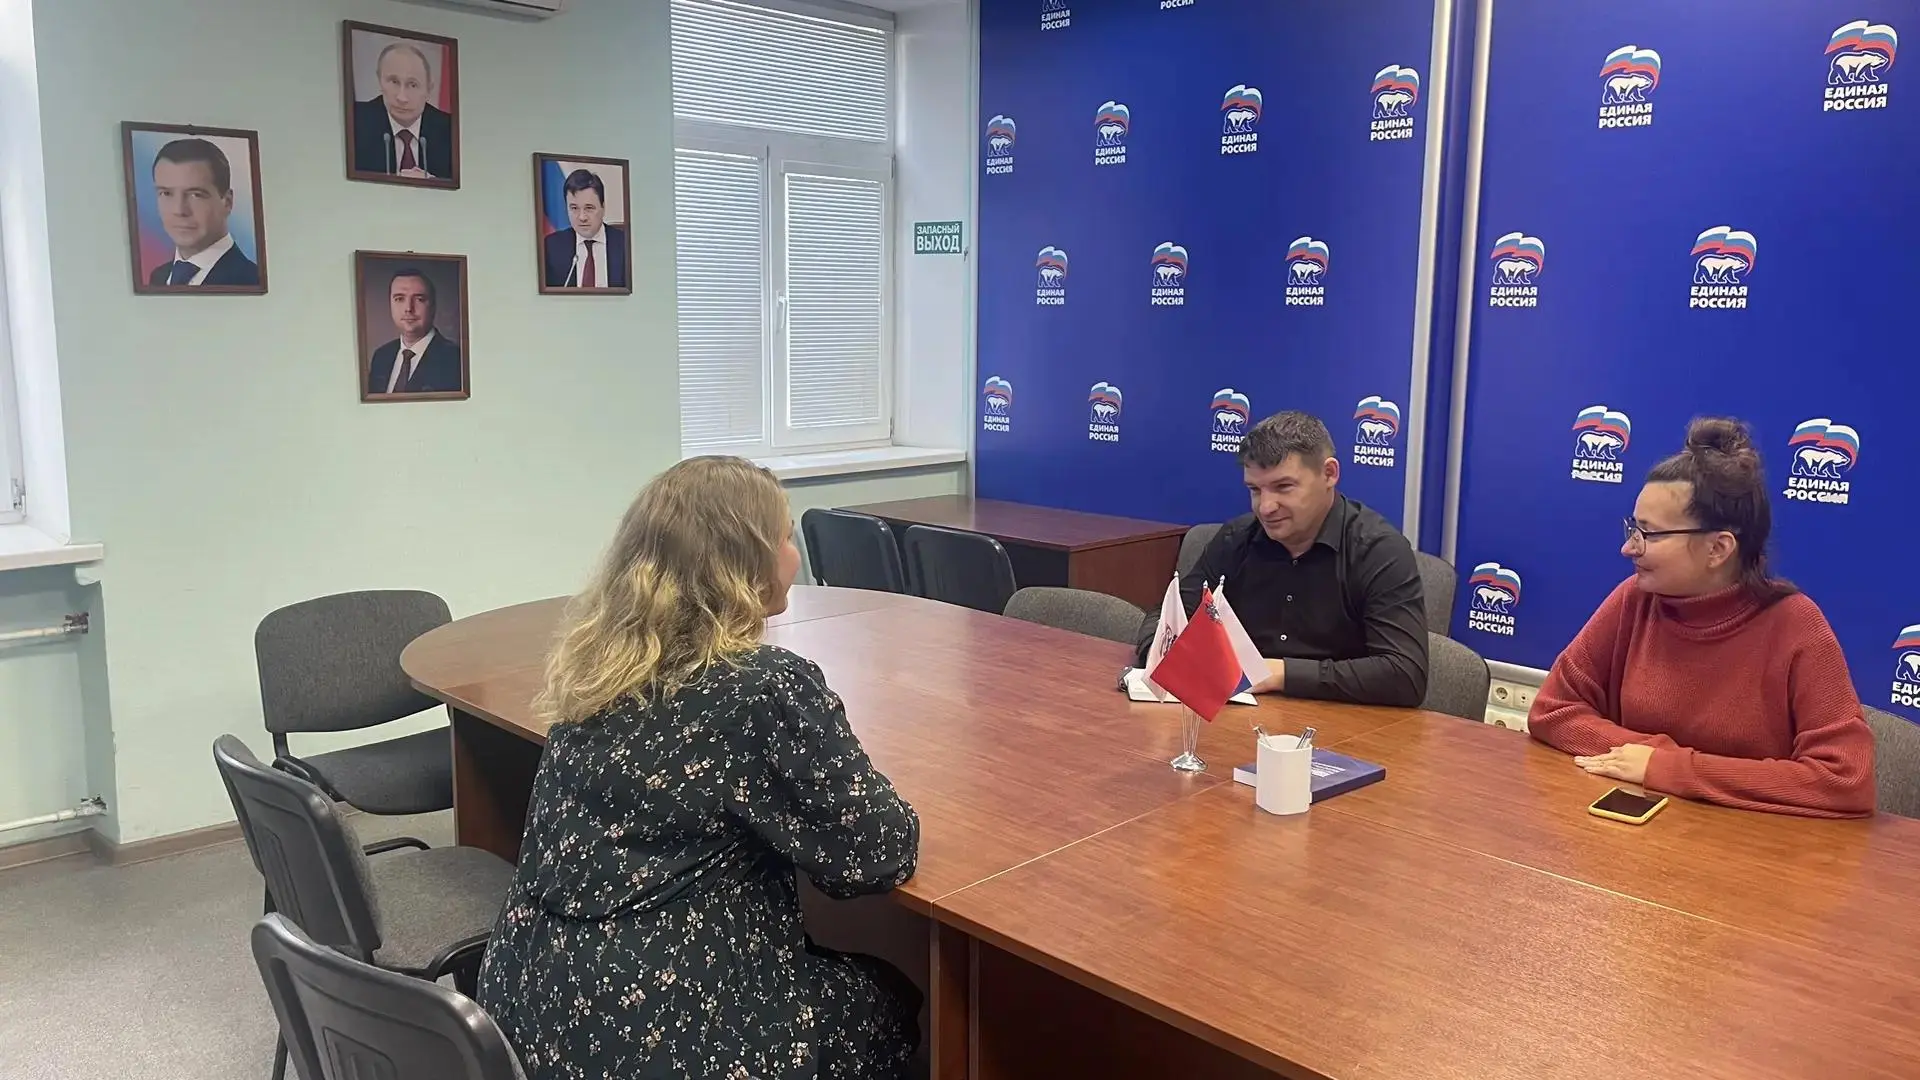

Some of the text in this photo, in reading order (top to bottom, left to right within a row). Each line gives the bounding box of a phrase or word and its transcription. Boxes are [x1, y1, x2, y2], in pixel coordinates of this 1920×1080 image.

[1041, 9, 1070, 21] ЕДИНАЯ
[1041, 18, 1070, 30] РОССИЯ
[1825, 83, 1888, 99] ЕДИНАЯ
[1600, 102, 1653, 117] ЕДИНАЯ
[1823, 96, 1887, 111] РОССИЯ
[1371, 117, 1413, 131] ЕДИНАЯ
[1598, 114, 1652, 129] РОССИЯ
[1221, 133, 1258, 145] ЕДИНАЯ
[1370, 127, 1413, 141] РОССИЯ
[1095, 146, 1126, 156] ЕДИНАЯ
[1221, 142, 1258, 154] РОССИЯ
[986, 156, 1013, 165] ЕДИНАЯ
[1095, 154, 1126, 165] РОССИЯ
[986, 165, 1013, 174] РОССИЯ
[916, 223, 960, 235] ЗАПАСНЫЙ
[916, 234, 960, 253] ВЫХОД
[1036, 289, 1065, 297] ЕДИНАЯ
[1151, 288, 1184, 296] ЕДИНАЯ
[1286, 286, 1324, 296] ЕДИНАЯ
[1491, 286, 1538, 296] ЕДИНАЯ
[1691, 286, 1748, 297] ЕДИНАЯ
[1036, 297, 1065, 305] РОССИЯ
[1151, 297, 1184, 305] РОССИЯ
[1285, 296, 1324, 306] РОССИЯ
[1490, 296, 1537, 307] РОССИЯ
[1690, 297, 1747, 309] РОССИЯ
[983, 415, 1010, 424] ЕДИНАЯ
[983, 422, 1010, 432] РОССИЯ
[1089, 423, 1119, 433] ЕДИНАЯ
[1089, 431, 1119, 442] РОССИЯ
[1211, 442, 1240, 453] РОССИ
[1354, 445, 1394, 457] ЕДИНАЯ
[1354, 454, 1394, 467] РОССИЯ
[1572, 458, 1623, 472] ЕДИНАЯ
[1788, 477, 1850, 492] ЕДИНАЯ
[1469, 610, 1515, 625] ЕДИНАЯ
[1468, 620, 1514, 635] РОССИЯ
